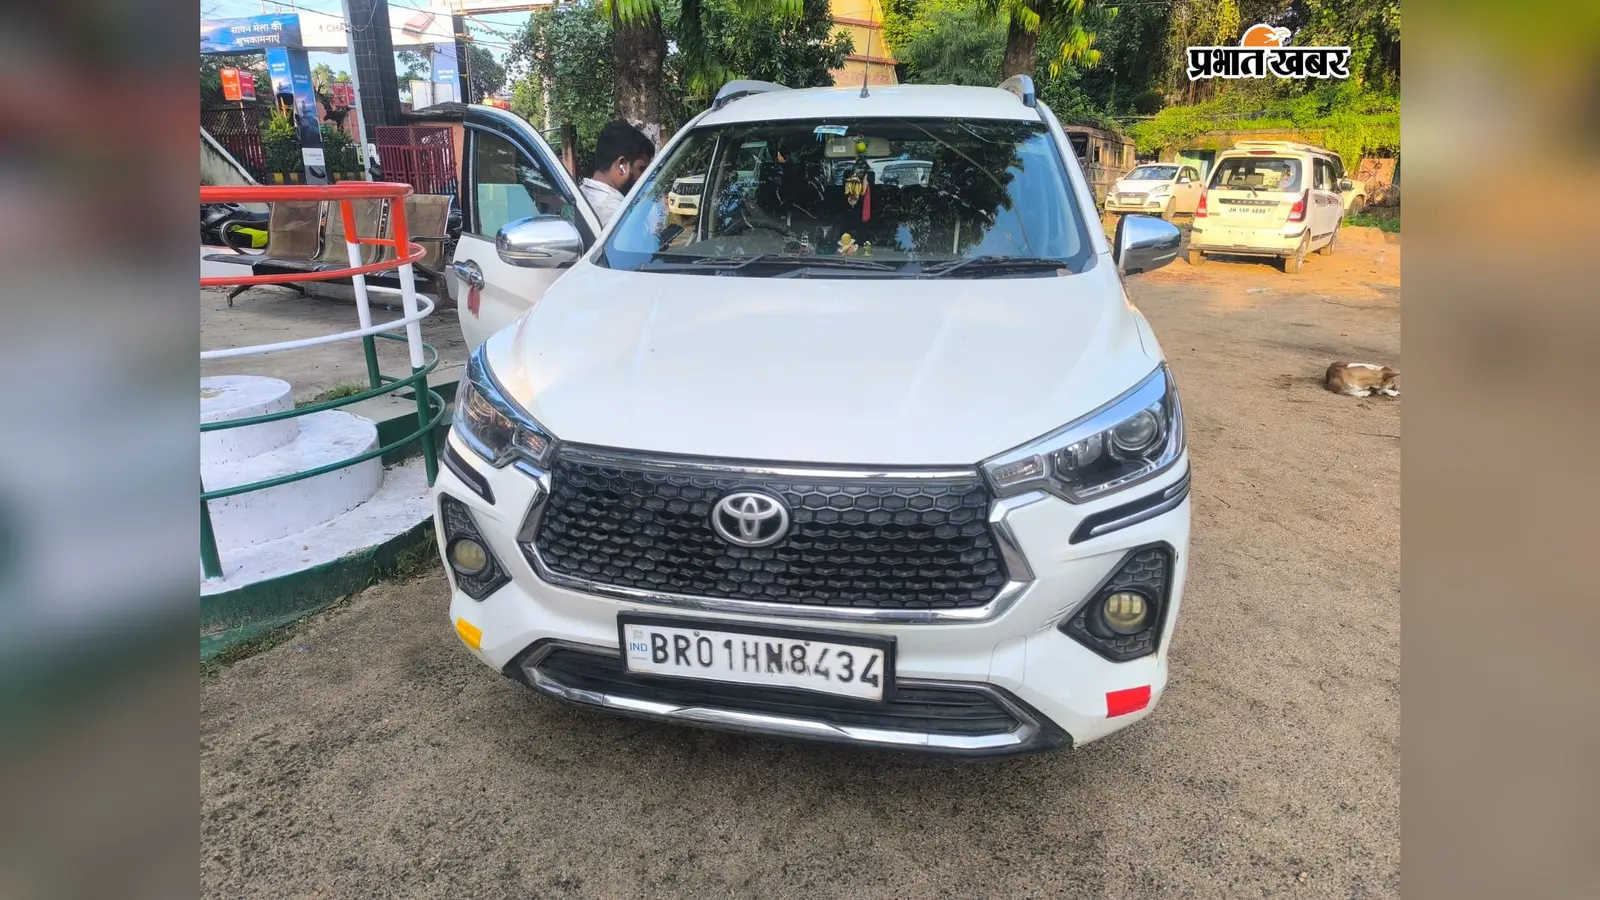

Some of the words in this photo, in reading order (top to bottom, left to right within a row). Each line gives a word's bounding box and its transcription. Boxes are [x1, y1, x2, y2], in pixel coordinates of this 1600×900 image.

[230, 25, 251, 34] सावन
[252, 22, 269, 33] मेला
[271, 20, 282, 31] की
[629, 642, 648, 652] IND
